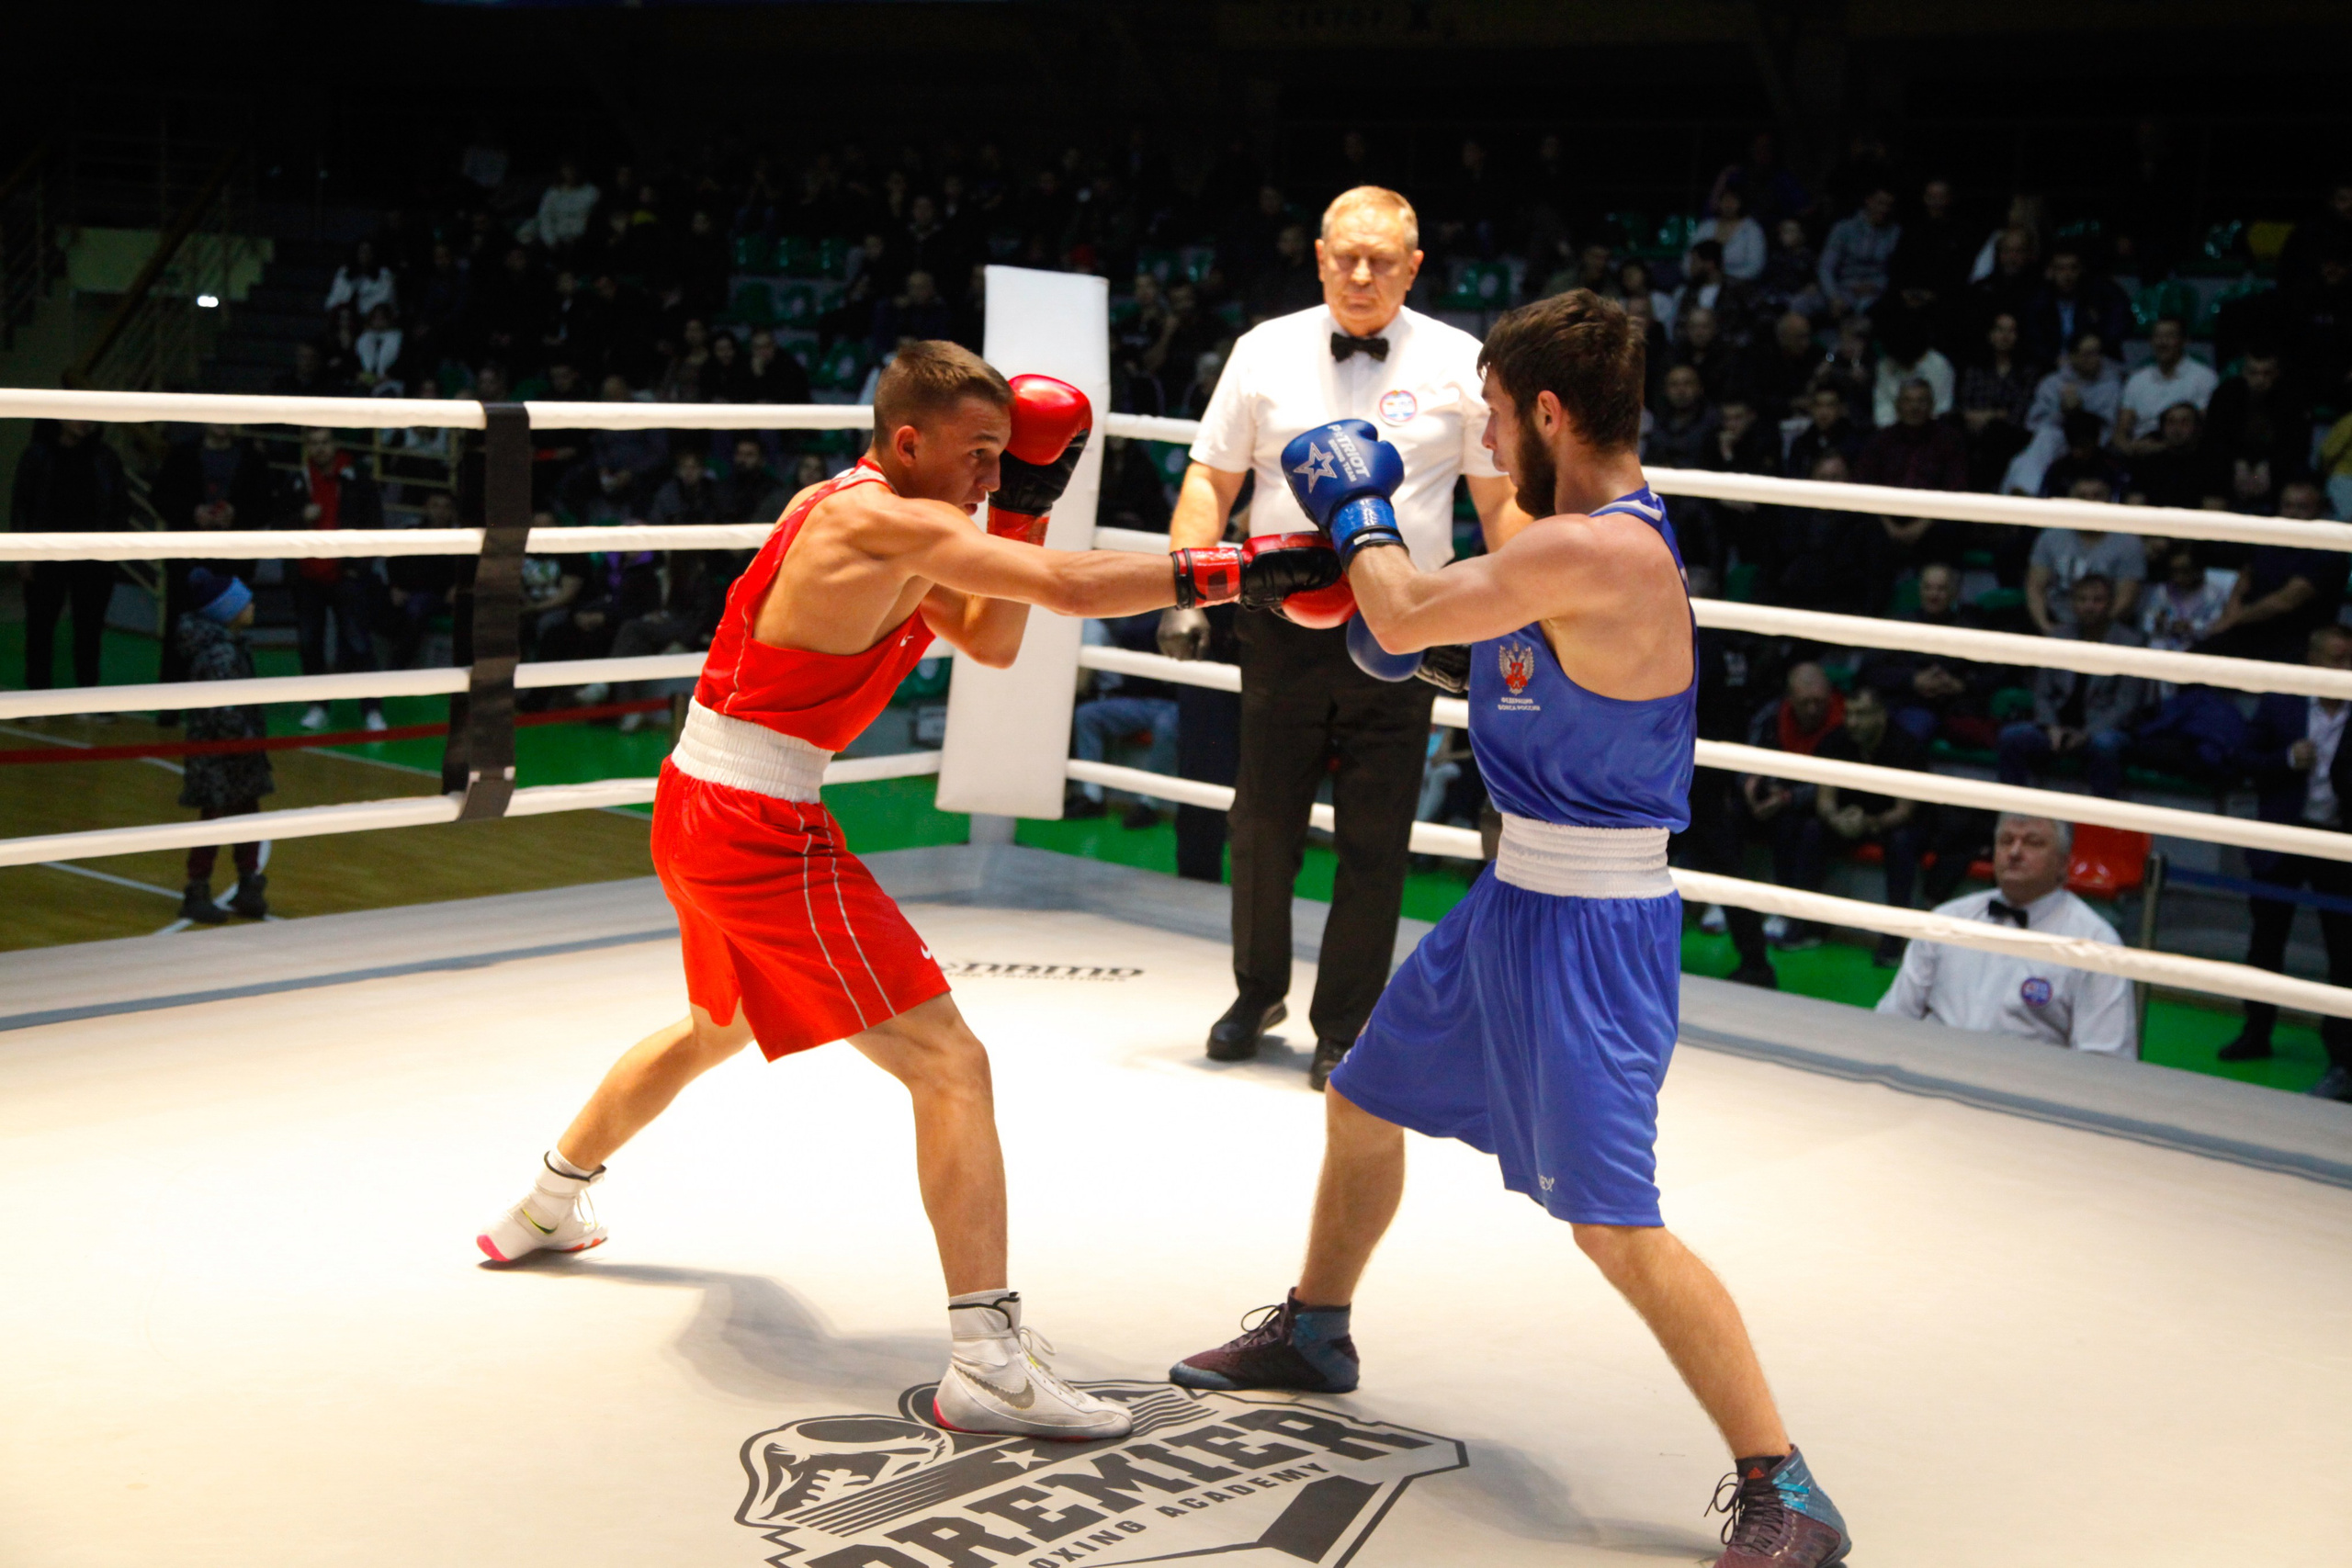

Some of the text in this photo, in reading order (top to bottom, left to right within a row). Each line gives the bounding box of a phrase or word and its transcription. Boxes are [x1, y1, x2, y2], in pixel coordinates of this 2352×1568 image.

[1327, 424, 1371, 478] PATRIOT
[1342, 461, 1357, 482] TEAM
[1028, 1462, 1330, 1568] OXING ACADEMY
